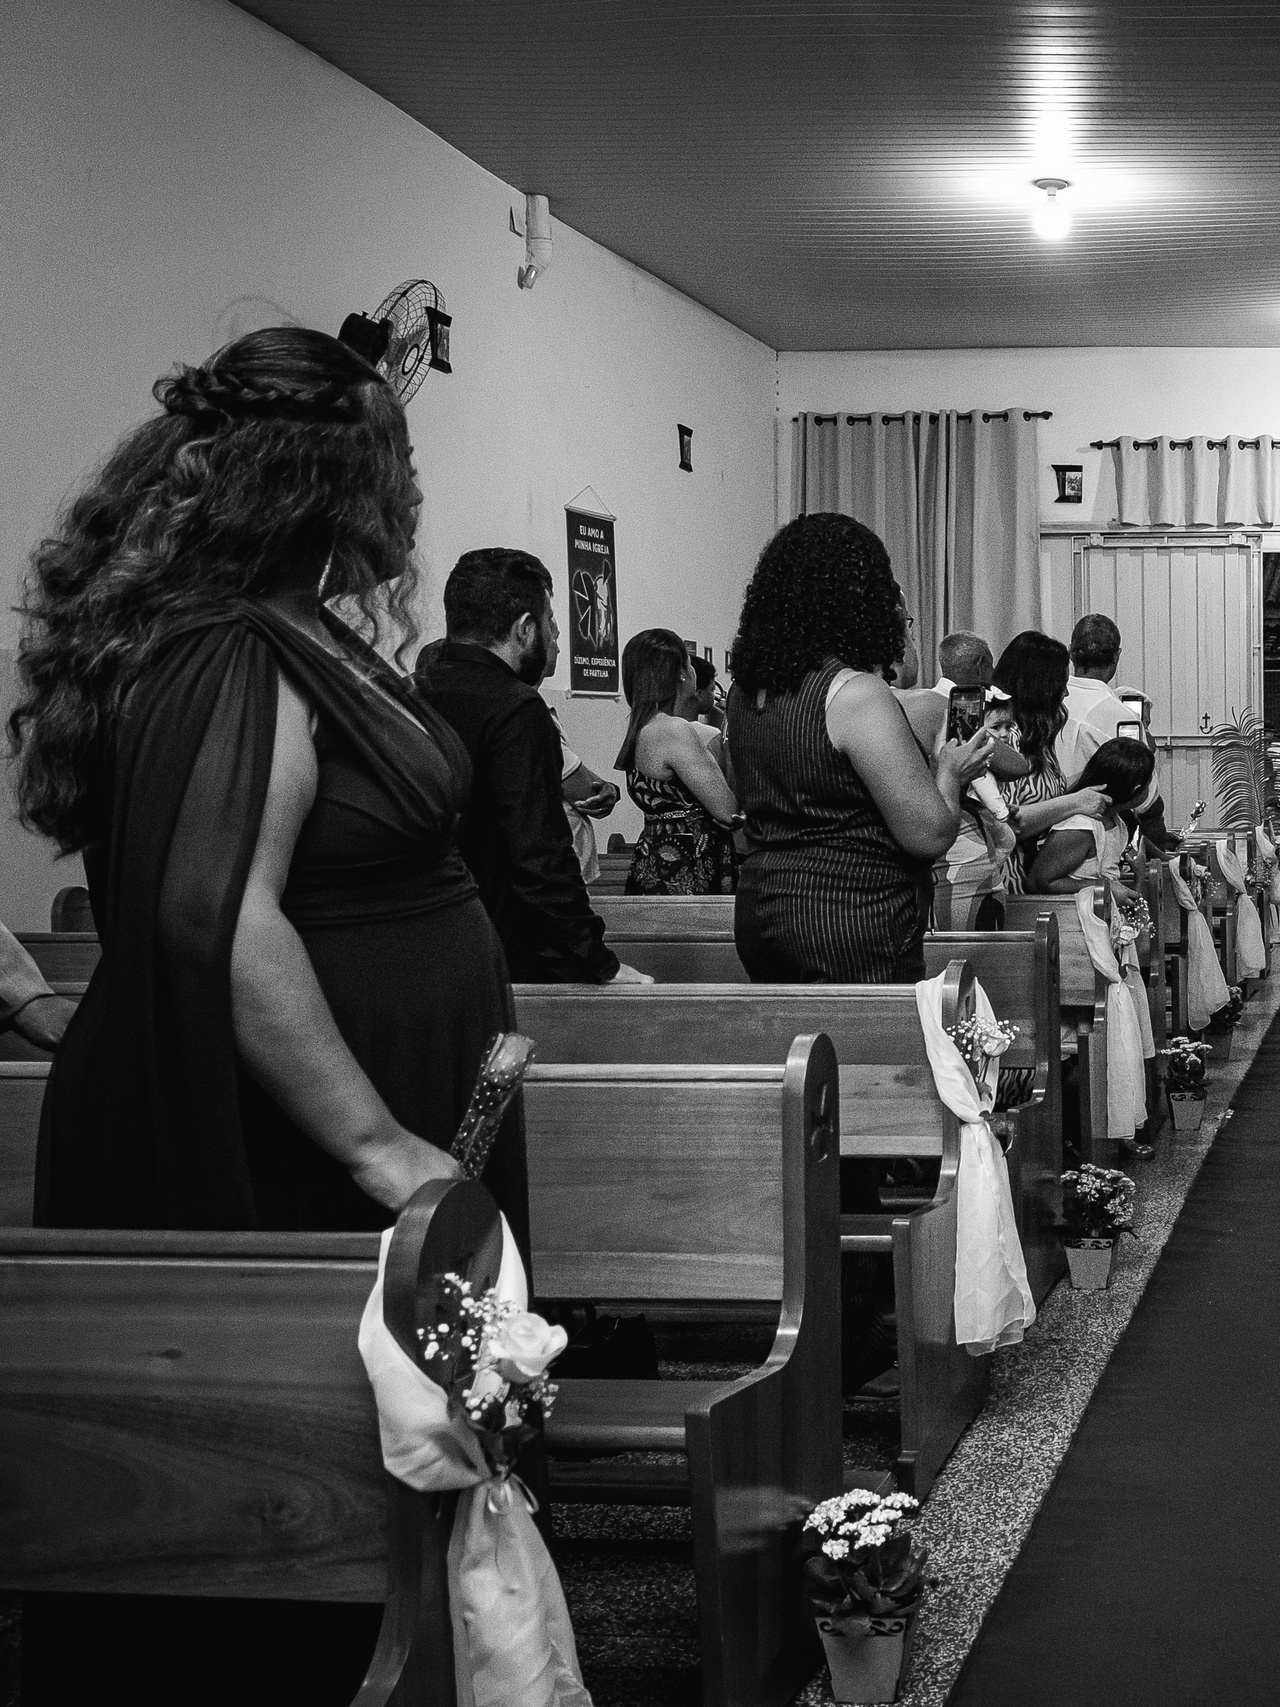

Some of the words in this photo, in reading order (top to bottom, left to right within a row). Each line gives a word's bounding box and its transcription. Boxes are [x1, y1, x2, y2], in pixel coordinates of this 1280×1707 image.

[579, 524, 587, 536] EU
[587, 527, 600, 539] AMO
[600, 530, 605, 540] A
[574, 538, 592, 552] MINHA
[592, 542, 610, 555] IGREJA
[583, 668, 589, 677] DE
